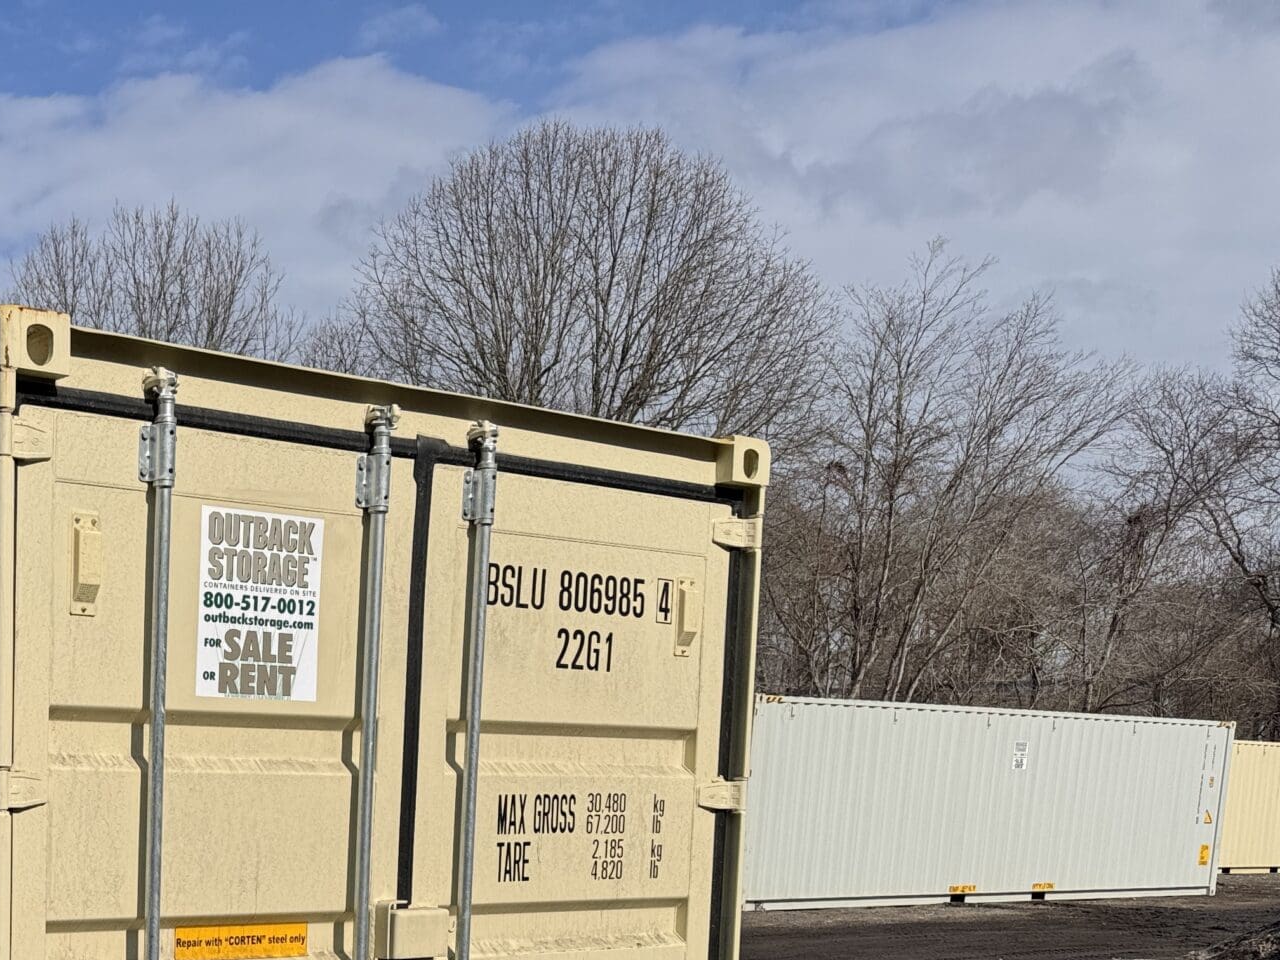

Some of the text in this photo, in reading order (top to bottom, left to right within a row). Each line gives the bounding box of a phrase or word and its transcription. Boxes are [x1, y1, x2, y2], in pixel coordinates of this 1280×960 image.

[207, 510, 316, 556] OUTBACK
[207, 546, 311, 589] STORAGE
[203, 581, 317, 598] CONTAINERS DELIVERED ON SITE
[203, 591, 316, 616] 800-517-0012
[486, 562, 671, 622] BSLU 806985 4
[204, 611, 314, 630] outbackstorage.com
[204, 628, 294, 665] FOR SALE
[556, 627, 614, 673] 22G1
[203, 662, 297, 697] OR RENT
[496, 793, 577, 835] MAX GROSS
[587, 793, 666, 817] 30,480 kg
[586, 814, 662, 835] 67,200 lb
[496, 841, 532, 883] TARE
[591, 839, 663, 862] 2,185 kg
[590, 860, 659, 881] 4,820 lb
[175, 938, 203, 950] Repair
[205, 936, 223, 948] with
[268, 934, 288, 944] steel
[289, 933, 306, 946] only
